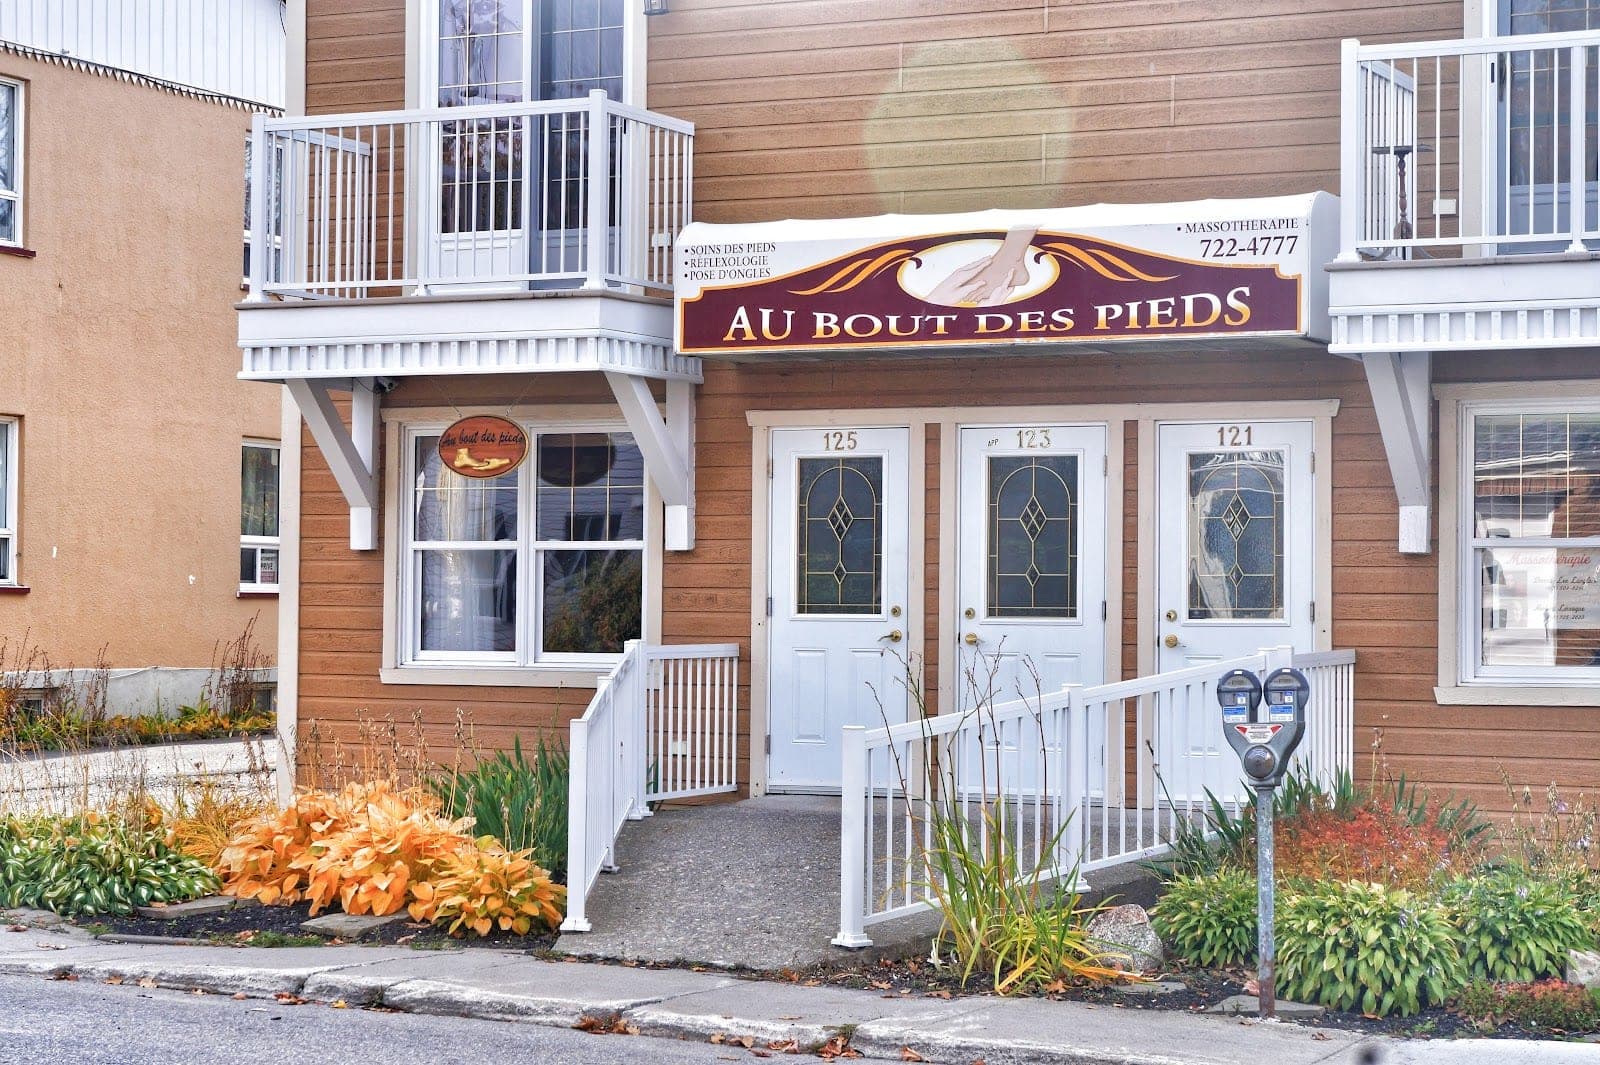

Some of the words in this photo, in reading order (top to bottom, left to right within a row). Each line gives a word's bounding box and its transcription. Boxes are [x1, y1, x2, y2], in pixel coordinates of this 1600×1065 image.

[690, 244, 721, 256] SOINS
[724, 243, 744, 254] DES
[747, 241, 777, 253] PIEDS
[1199, 235, 1299, 258] 722-4777
[690, 269, 716, 281] POSE
[718, 267, 772, 280] D'ONGLES
[722, 304, 796, 342] AU
[811, 311, 958, 339] BOUT
[974, 308, 1076, 334] DES
[1093, 286, 1252, 330] PIEDS
[459, 428, 479, 444] bout
[480, 427, 497, 443] des
[498, 430, 524, 447] pieds
[822, 430, 859, 451] 125
[1016, 428, 1052, 449] 123
[1216, 425, 1253, 446] 121
